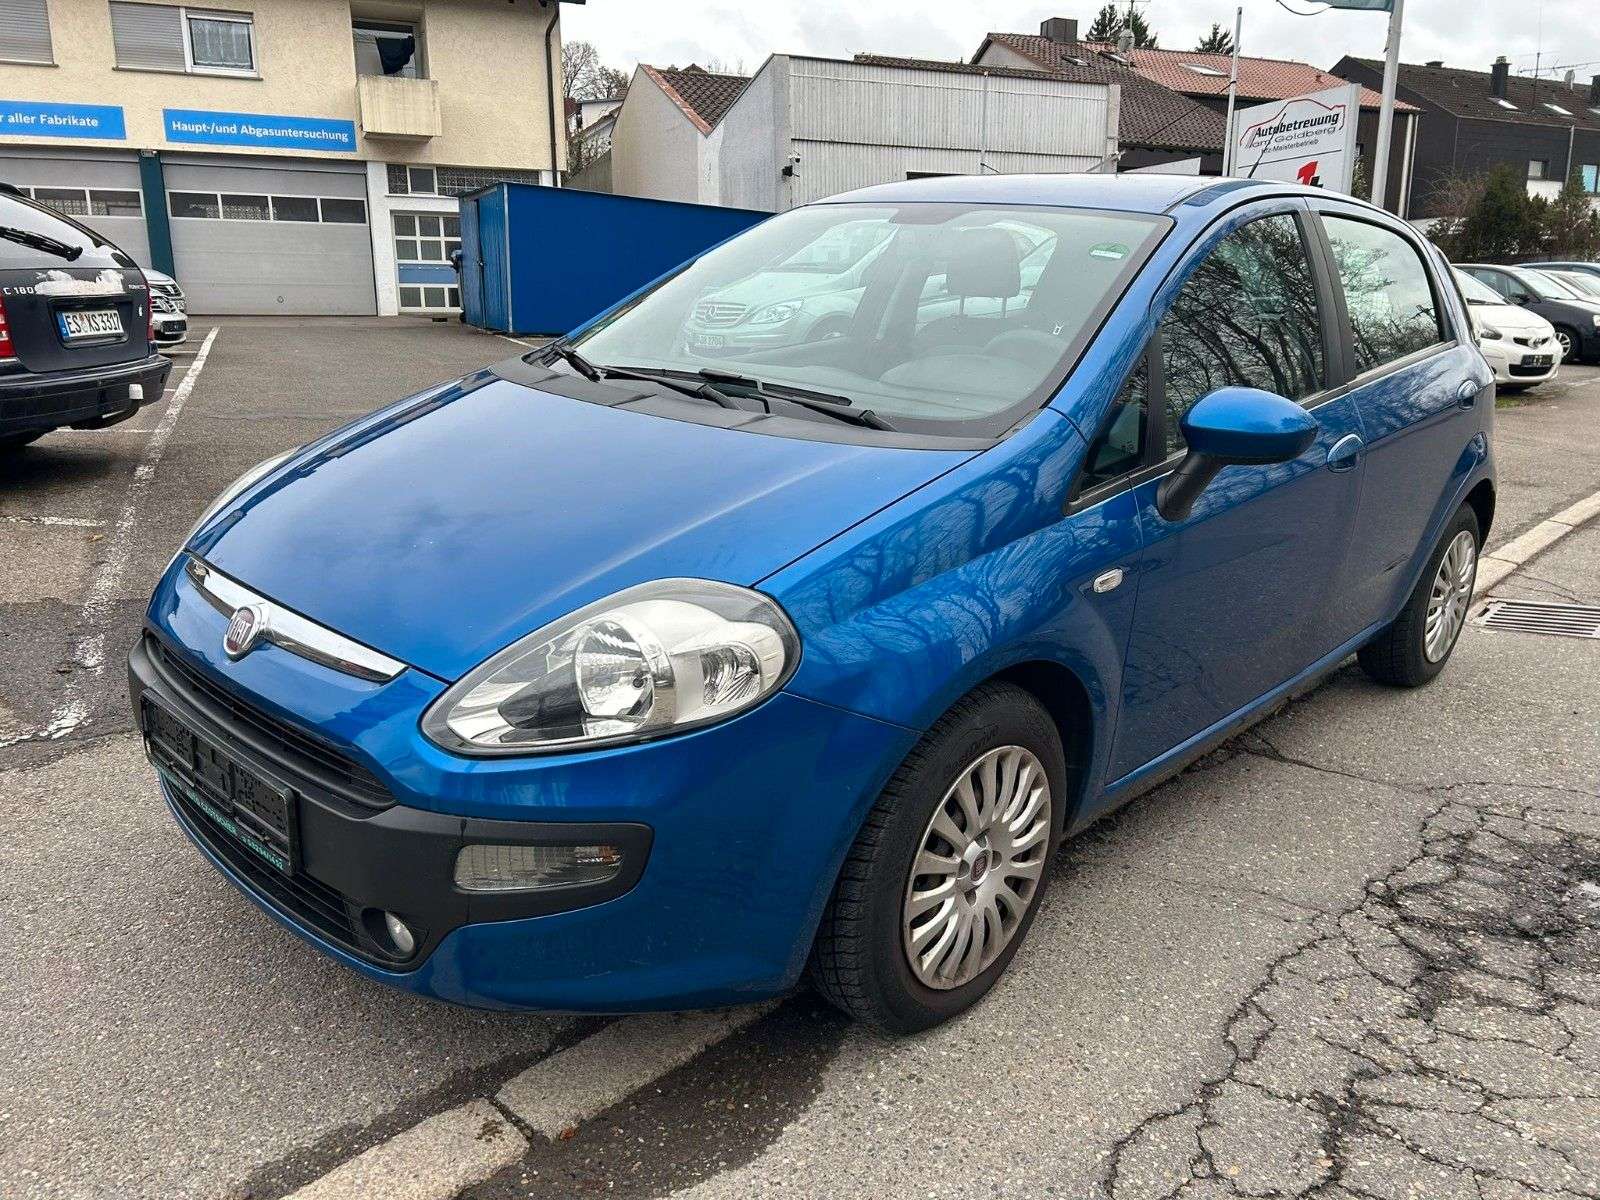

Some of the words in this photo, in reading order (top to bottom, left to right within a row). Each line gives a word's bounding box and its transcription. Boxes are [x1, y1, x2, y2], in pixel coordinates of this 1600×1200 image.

[7, 112, 36, 124] aller
[39, 114, 99, 127] Fabrikate
[1255, 113, 1340, 138] Autobetreuung
[172, 120, 237, 135] Haupt-/und
[240, 124, 349, 143] Abgasuntersuchung
[1275, 126, 1336, 143] Goldberg
[3, 286, 12, 295] C
[14, 285, 35, 295] 180
[65, 314, 82, 334] ES
[97, 312, 121, 331] 3317
[226, 617, 252, 645] FIAT
